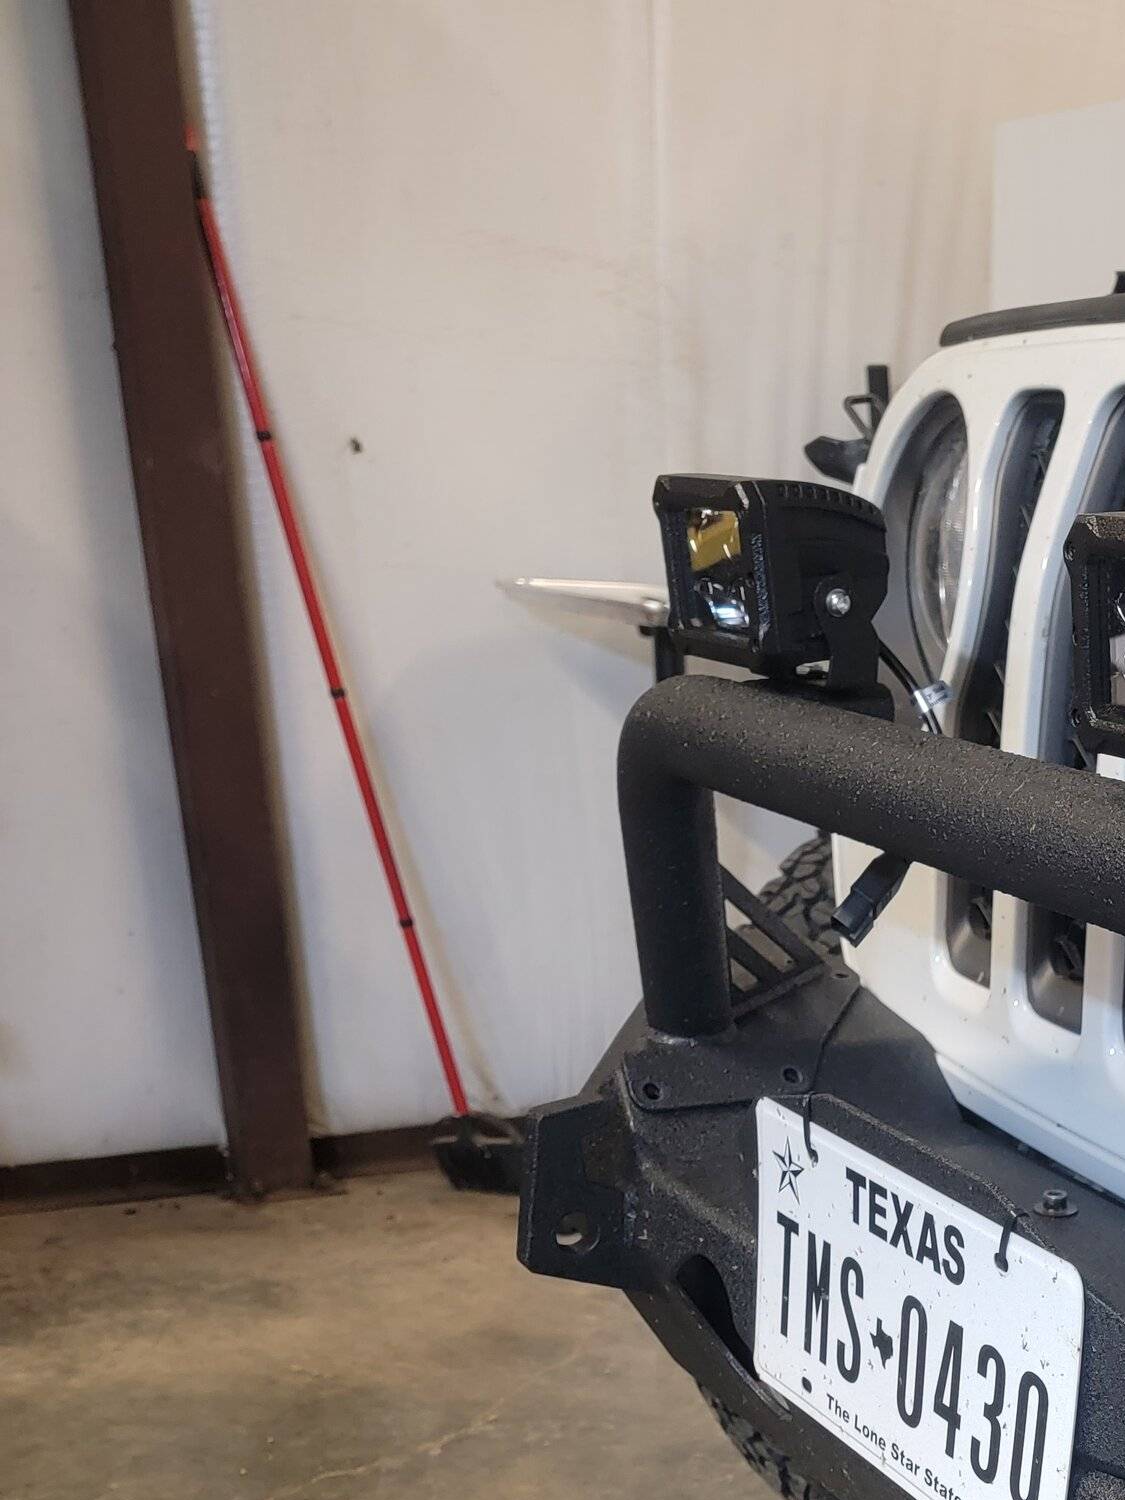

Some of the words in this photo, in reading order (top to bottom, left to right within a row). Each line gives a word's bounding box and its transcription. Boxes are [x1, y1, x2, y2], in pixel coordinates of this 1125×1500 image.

[845, 1167, 965, 1286] TEXAS
[776, 1211, 865, 1384] TMS
[826, 1393, 850, 1423] The
[854, 1414, 887, 1451] Lone
[891, 1443, 921, 1476] Star
